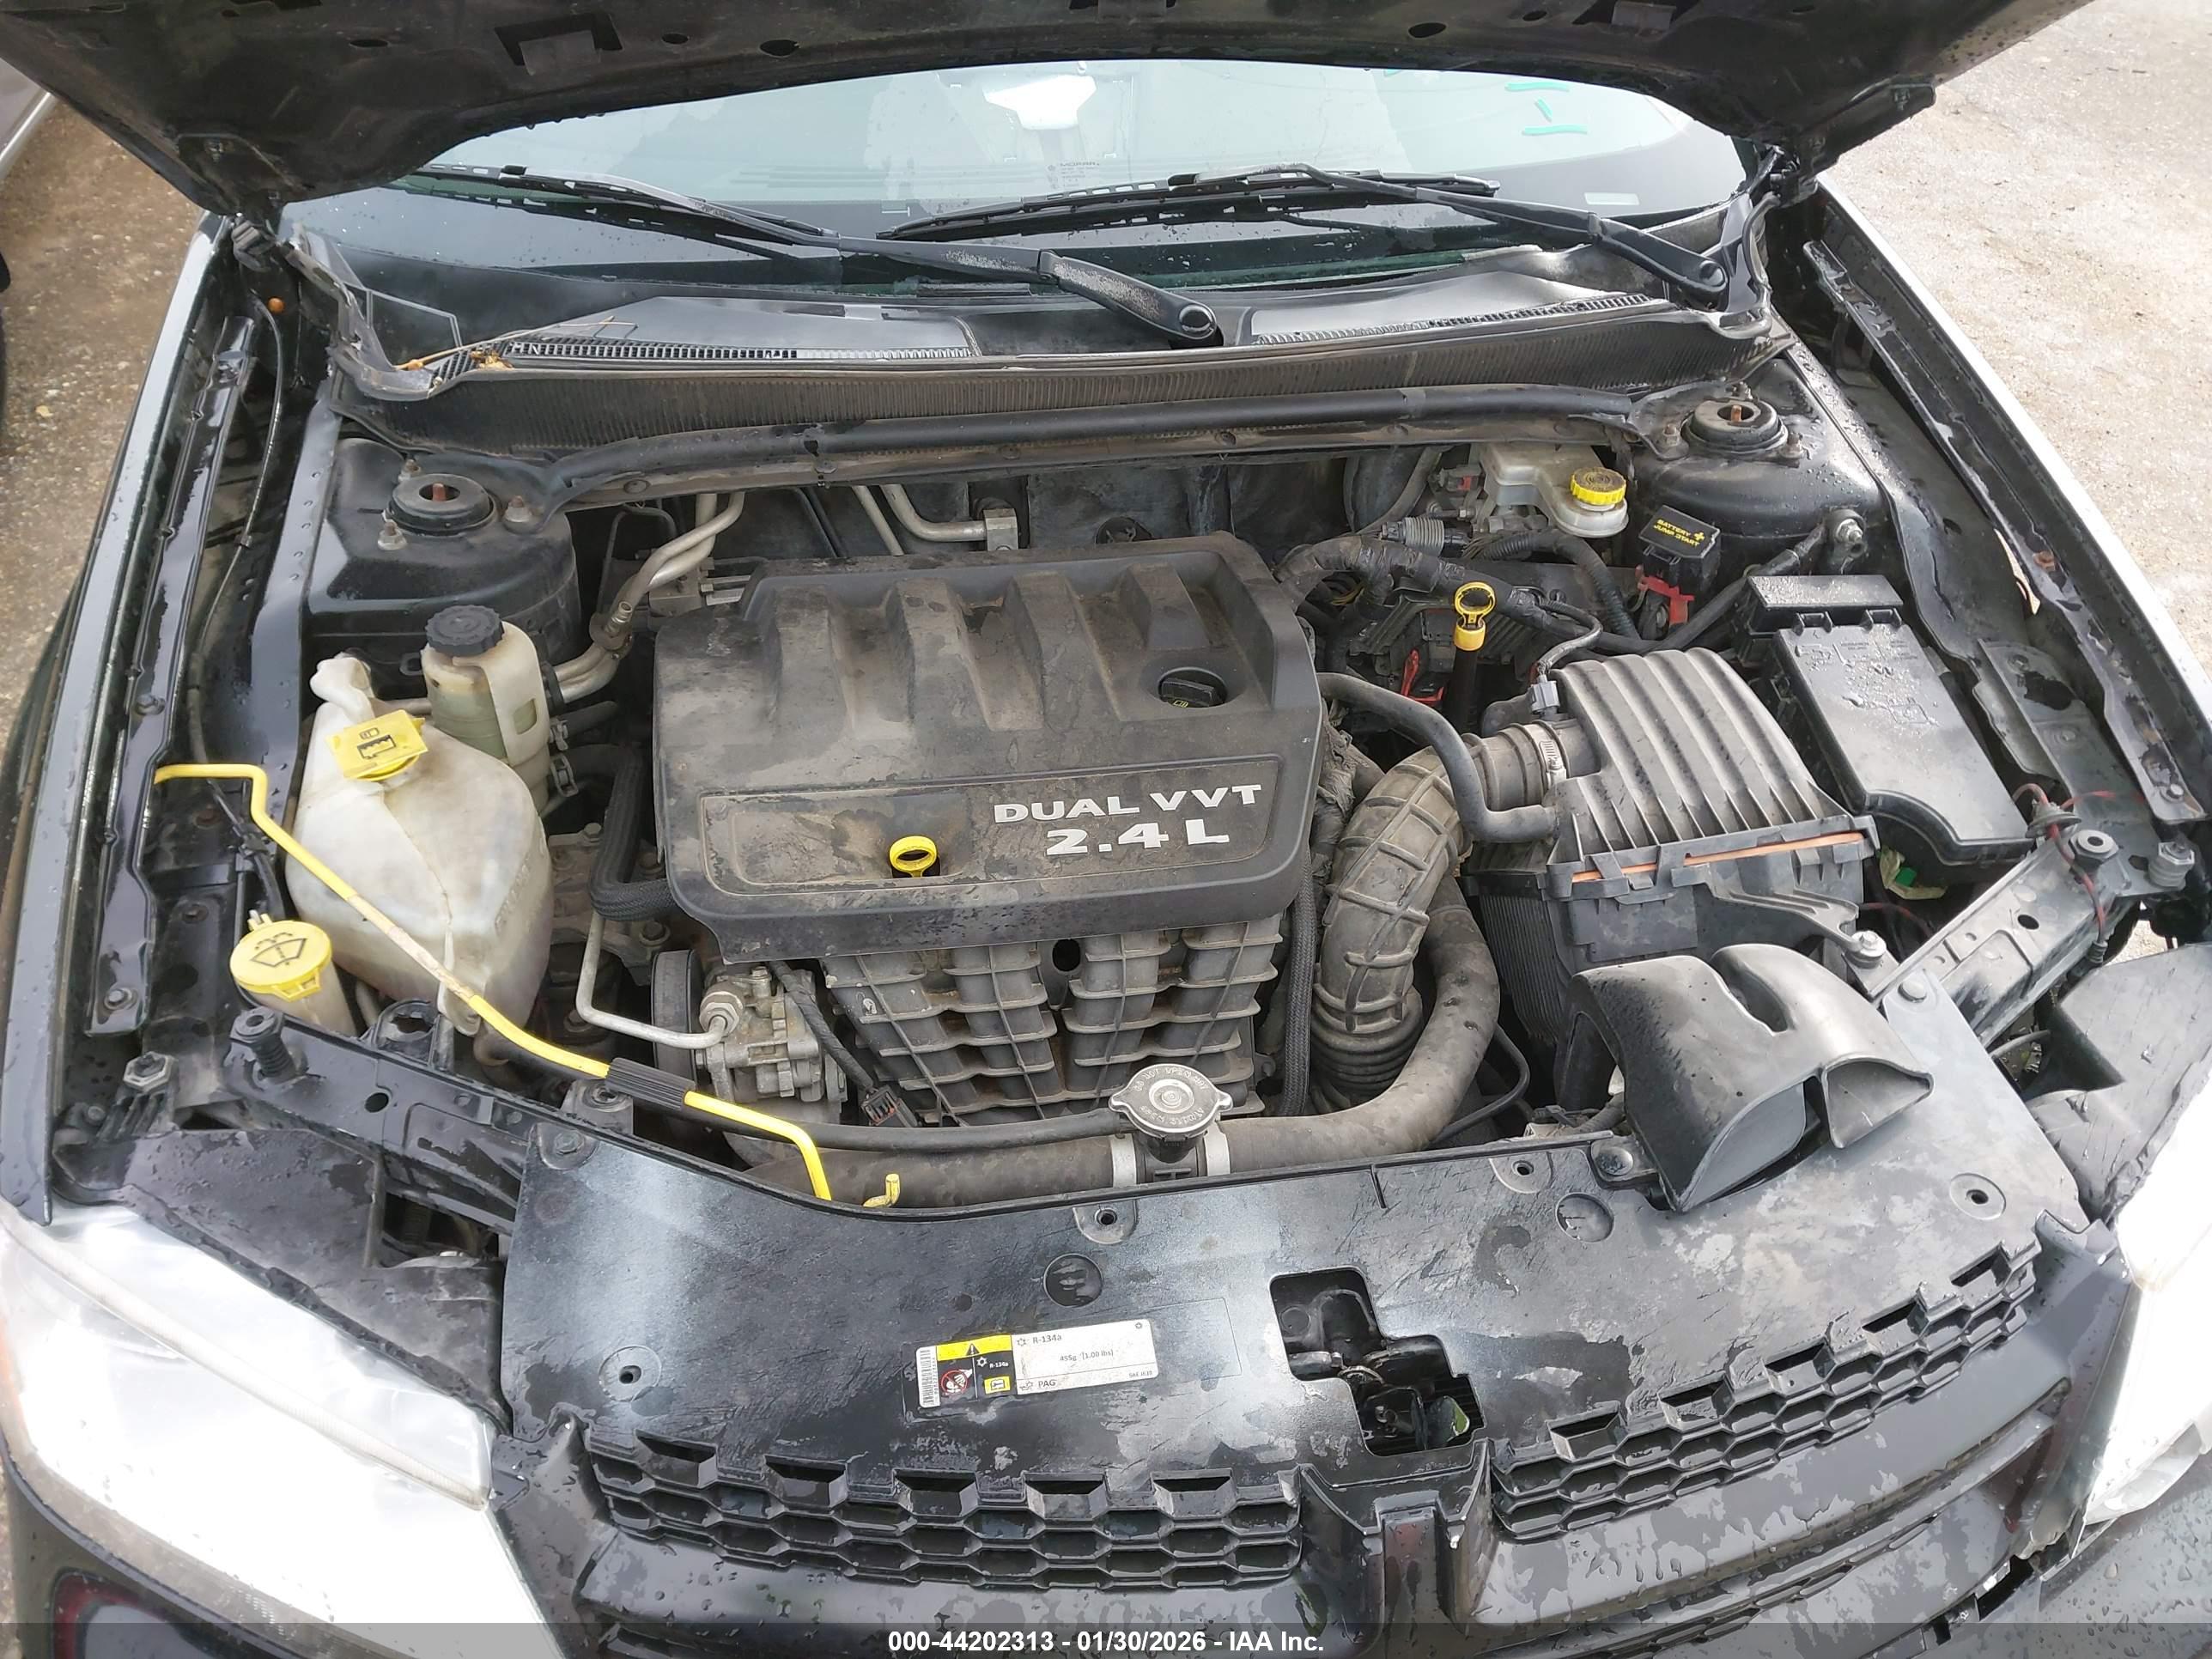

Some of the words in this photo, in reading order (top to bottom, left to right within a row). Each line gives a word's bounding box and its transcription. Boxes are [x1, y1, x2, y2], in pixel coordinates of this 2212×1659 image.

[1653, 524, 1674, 537] JUMP
[1674, 532, 1700, 547] START
[1656, 519, 1692, 537] BATTERY
[994, 796, 1140, 823] DUAL
[1150, 784, 1262, 811] VVT
[1044, 822, 1170, 856] 2.4
[1185, 818, 1230, 846] L
[1032, 1334, 1062, 1345] R-134a
[1037, 1379, 1056, 1389] PAG
